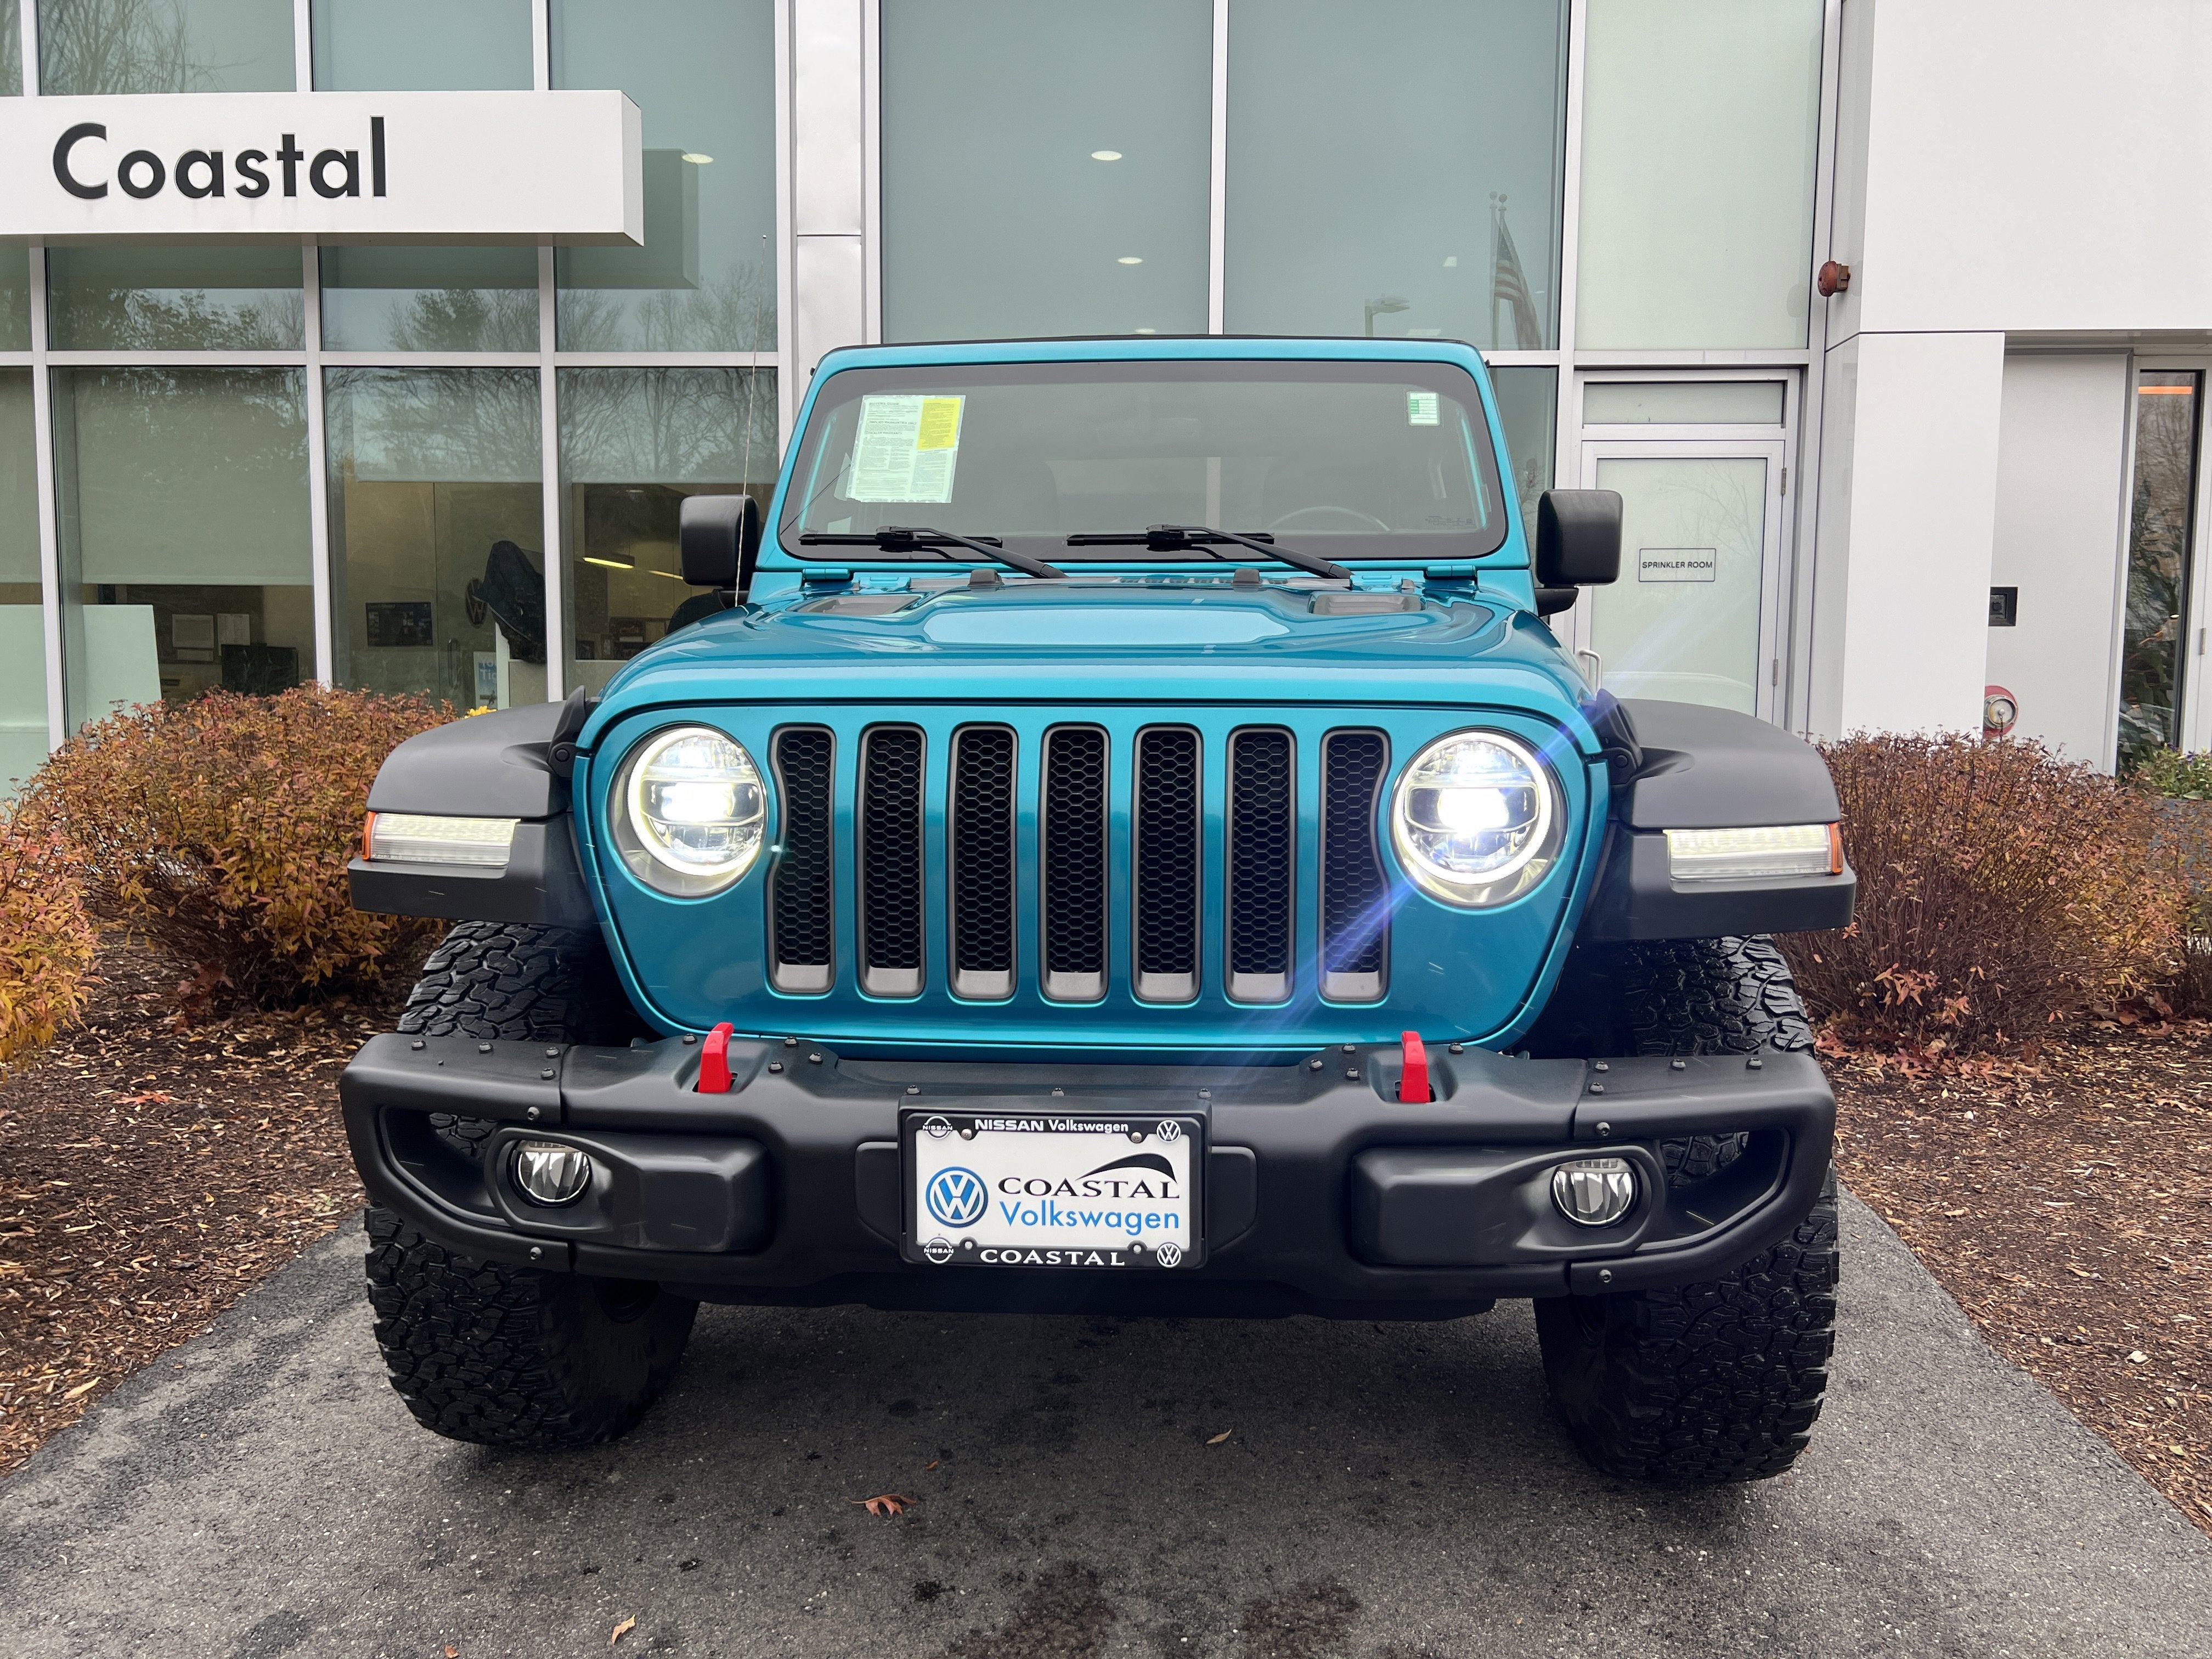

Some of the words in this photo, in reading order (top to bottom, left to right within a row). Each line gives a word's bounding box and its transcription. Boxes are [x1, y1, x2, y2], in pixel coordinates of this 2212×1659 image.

[53, 115, 387, 200] Coastal
[974, 1119, 1044, 1131] NISSAN
[1048, 1119, 1128, 1133] Volkswagen
[997, 1177, 1180, 1199] COASTAL
[999, 1200, 1180, 1236] Volkswagen
[980, 1249, 1125, 1266] COASTAL
